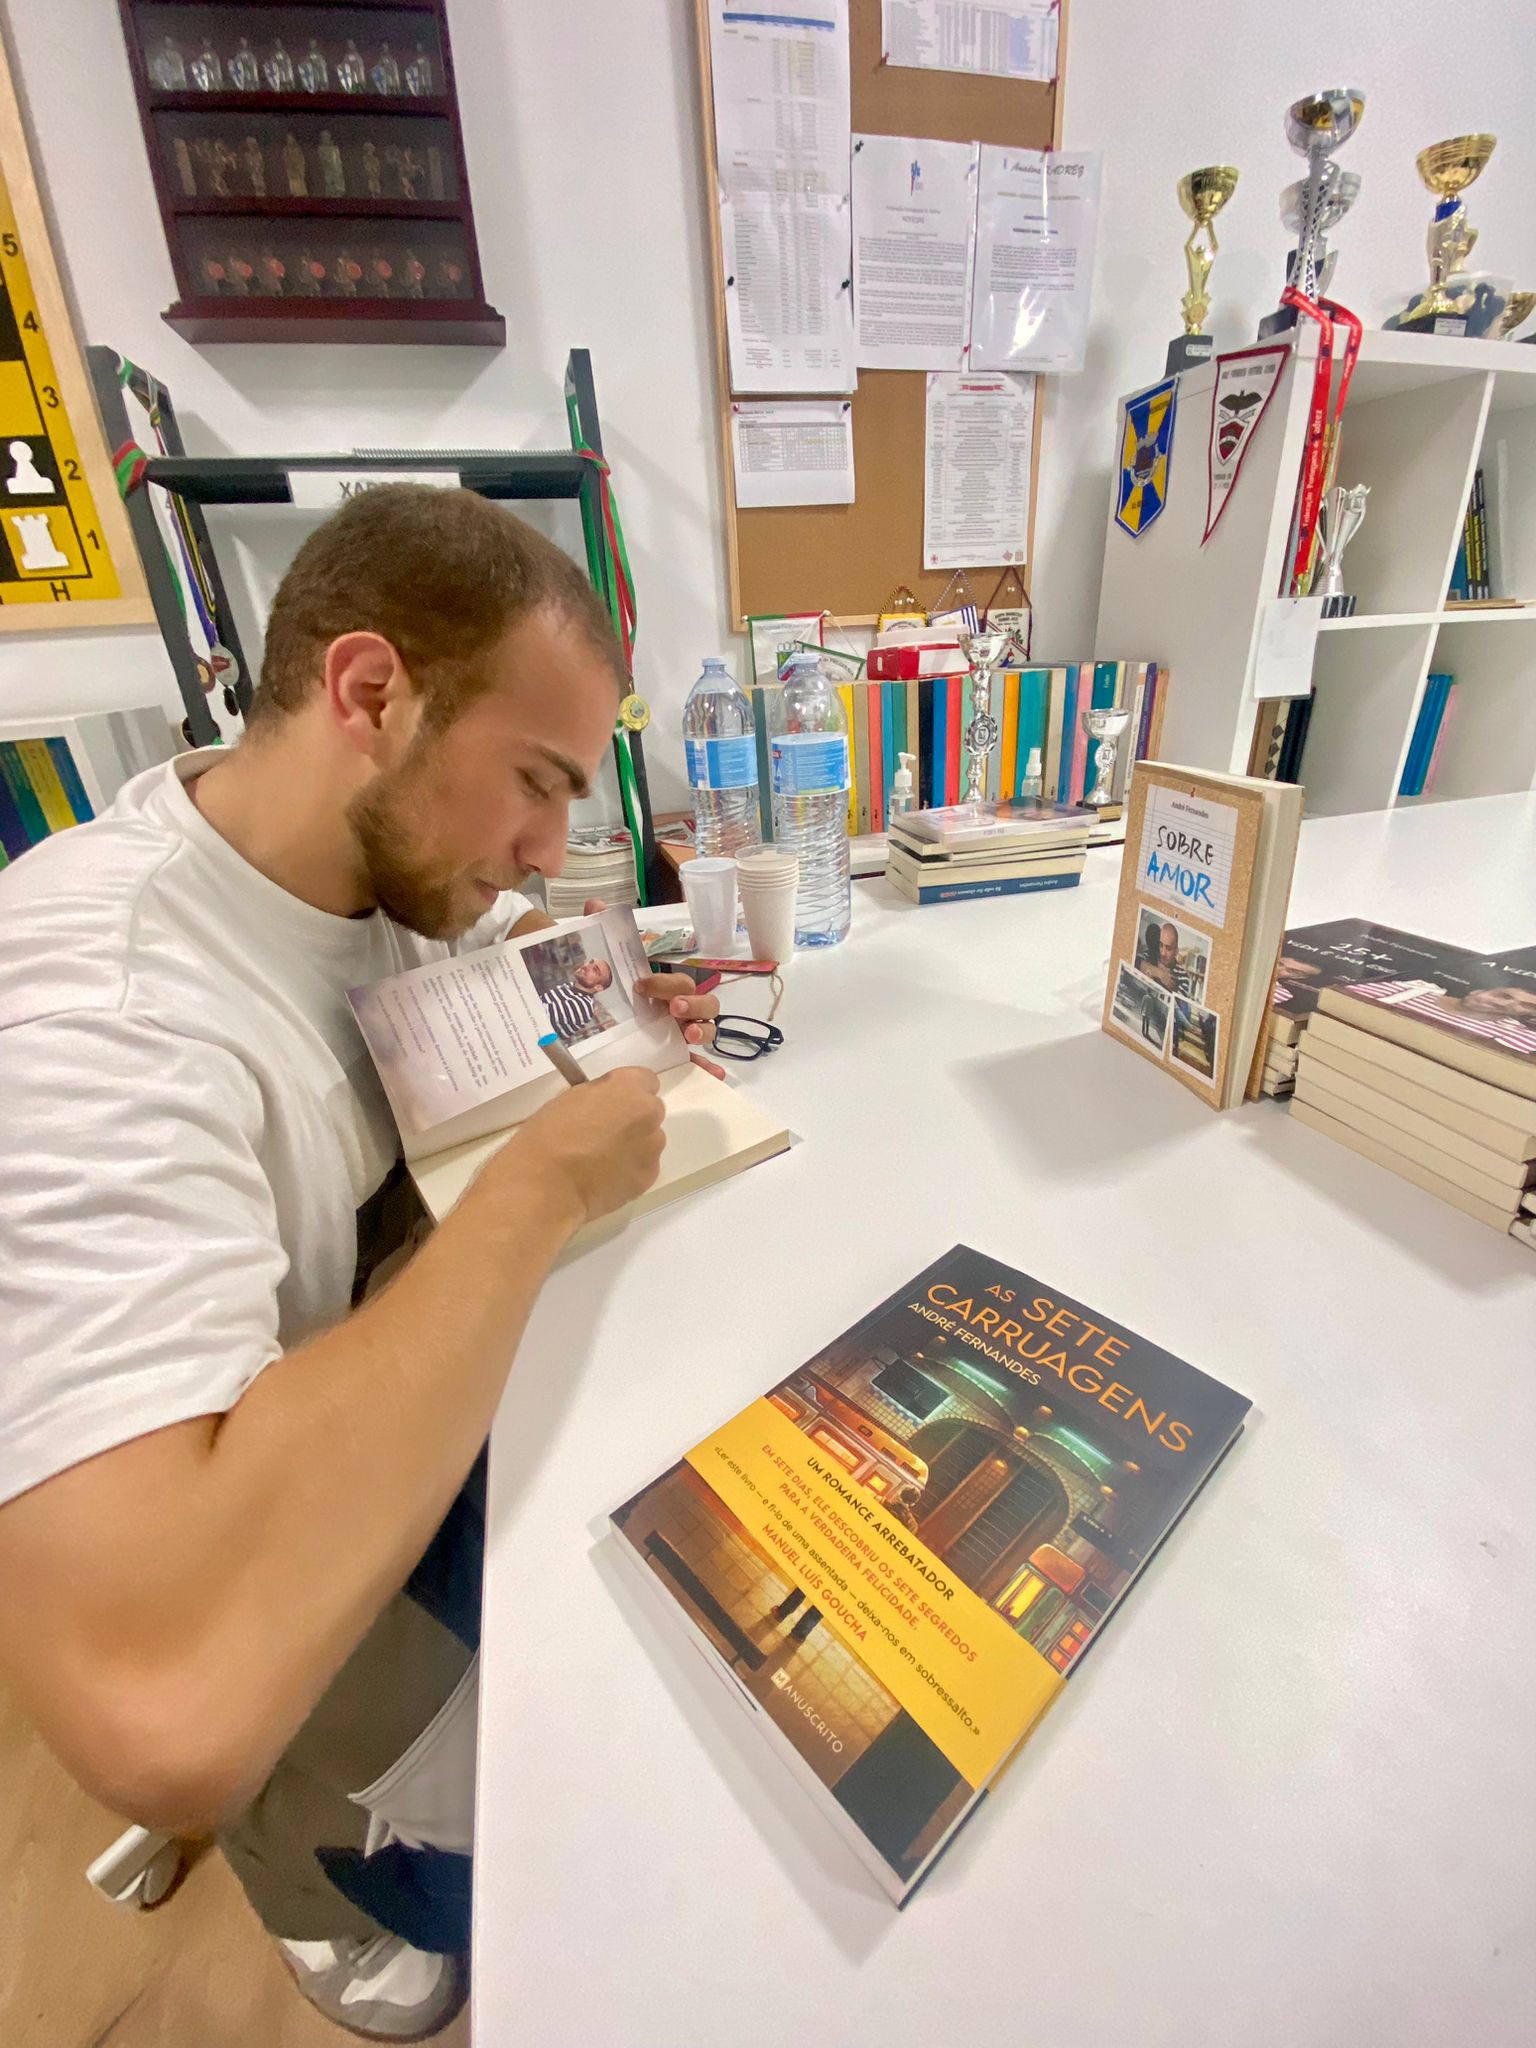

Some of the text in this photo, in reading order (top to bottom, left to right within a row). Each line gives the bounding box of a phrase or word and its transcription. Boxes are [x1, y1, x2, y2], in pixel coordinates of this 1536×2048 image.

[2, 233, 18, 257] 5
[23, 310, 39, 333] 4
[43, 386, 59, 409] 3
[64, 458, 81, 481] 2
[87, 529, 100, 551] 1
[50, 581, 71, 602] H
[1147, 850, 1215, 909] AMOR
[1157, 825, 1214, 866] SOBRE
[907, 1302, 1041, 1385] ANDRÉ FERNANDES
[983, 1283, 1129, 1366] AS SETE
[927, 1283, 1192, 1451] CARRUAGENS
[726, 1459, 742, 1475] este
[739, 1472, 756, 1492] livro
[761, 1497, 769, 1505] e
[780, 1518, 793, 1532] de
[790, 1529, 810, 1550] uma
[807, 1548, 849, 1592] assentada
[855, 1599, 900, 1647] deixa-nos
[898, 1645, 916, 1665] em
[760, 1443, 977, 1662] EM SETE DIAS, ELE DESCOBRIU OS SETE SEGREDOS
[778, 1481, 801, 1507] PARA
[798, 1505, 809, 1514] A
[808, 1511, 862, 1570] VERDADEIRA
[806, 1456, 954, 1600] UM ROMANCE ARREBATADOR
[761, 1522, 867, 1641] MANUEL LUÍS GOUCHA
[770, 1667, 843, 1755] MANUSCRITO
